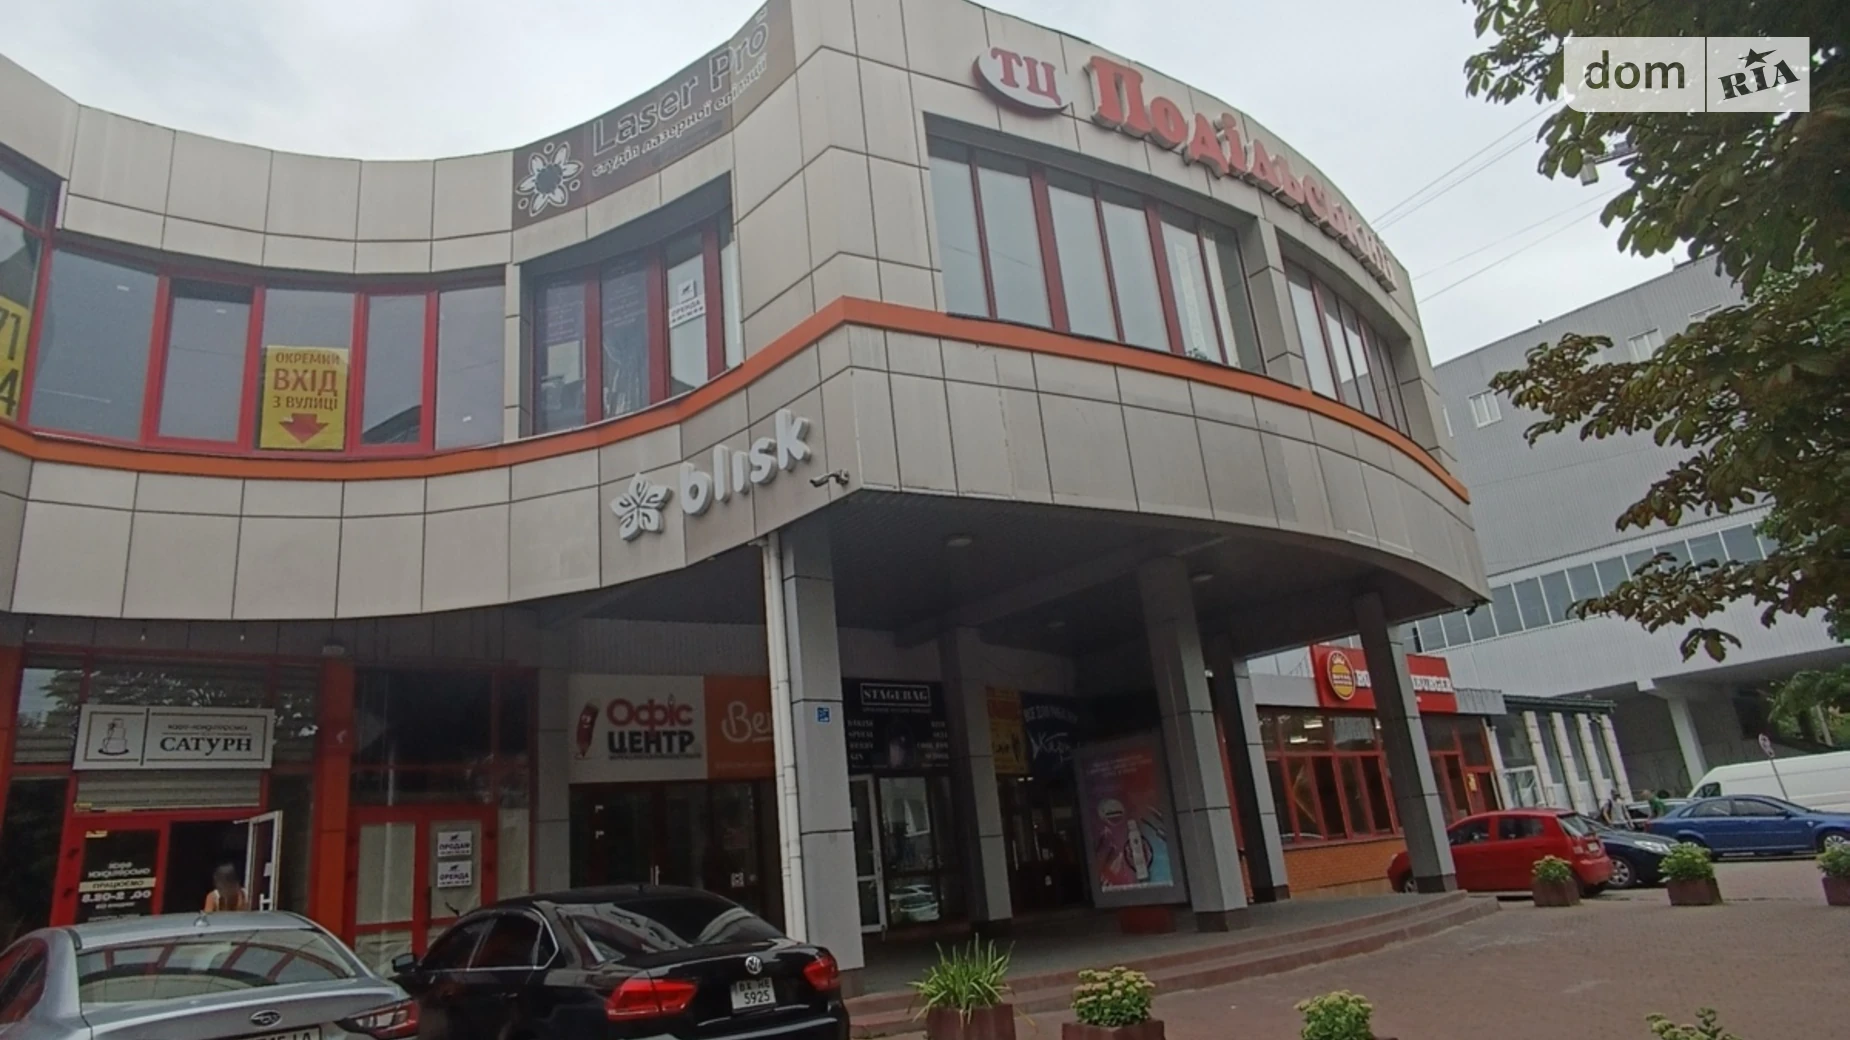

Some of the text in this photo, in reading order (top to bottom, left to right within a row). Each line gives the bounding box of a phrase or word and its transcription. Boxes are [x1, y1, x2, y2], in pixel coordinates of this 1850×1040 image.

[592, 22, 768, 157] Laser Pro
[991, 46, 1062, 106] ТЦ
[273, 368, 338, 397] ВХІД
[286, 395, 339, 411] ВУЛИЦІ
[679, 408, 811, 517] blisk
[606, 694, 693, 733] Офіс
[159, 736, 252, 757] САТУРН
[607, 731, 695, 754] ЦЕНТР
[744, 990, 770, 1004] 5925
